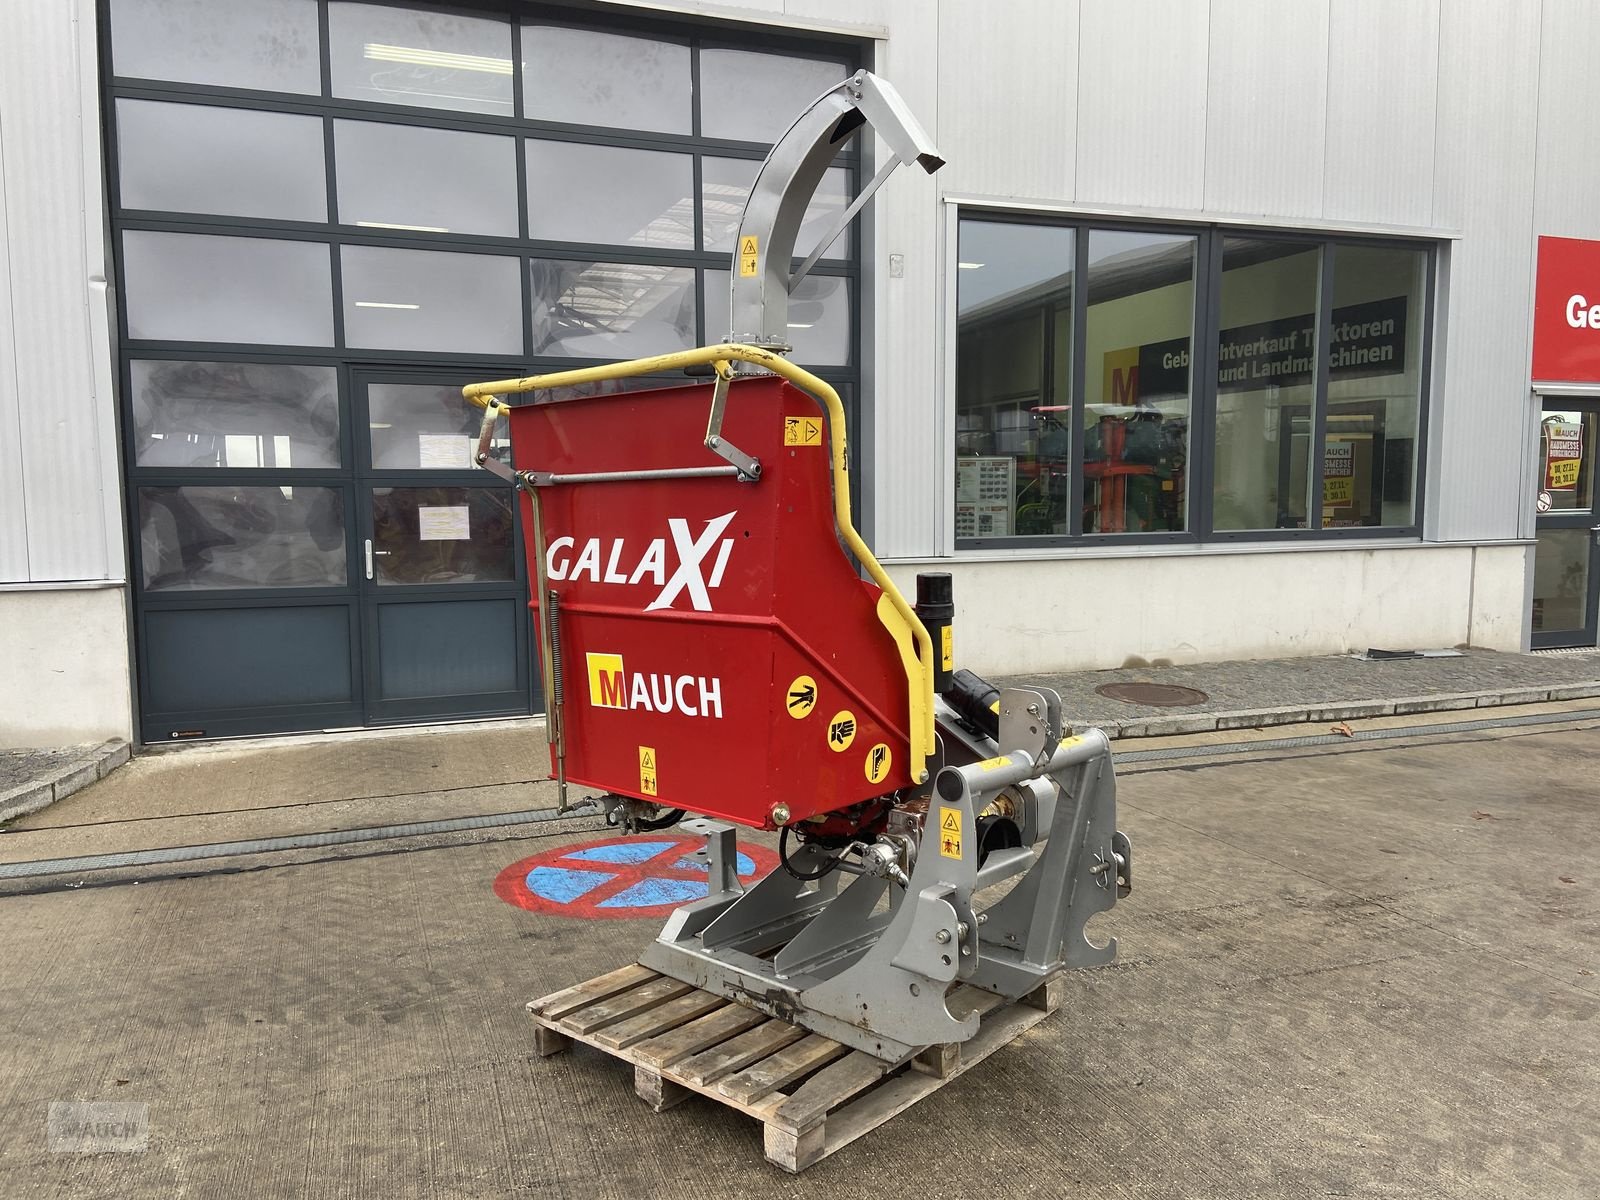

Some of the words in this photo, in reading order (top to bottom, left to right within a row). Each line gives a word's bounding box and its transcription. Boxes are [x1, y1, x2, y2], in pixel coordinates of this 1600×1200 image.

[1566, 294, 1600, 329] Ge
[1163, 331, 1297, 370] Gebhtverkauf
[1302, 318, 1394, 347] Tktoren
[1218, 362, 1248, 383] und
[1252, 345, 1393, 378] Landmachinen
[1555, 428, 1578, 438] MAUCH
[1324, 459, 1352, 468] SMESSE
[1326, 448, 1349, 456] AUCH
[546, 510, 738, 612] GALAXI
[598, 668, 723, 719] MAUCH
